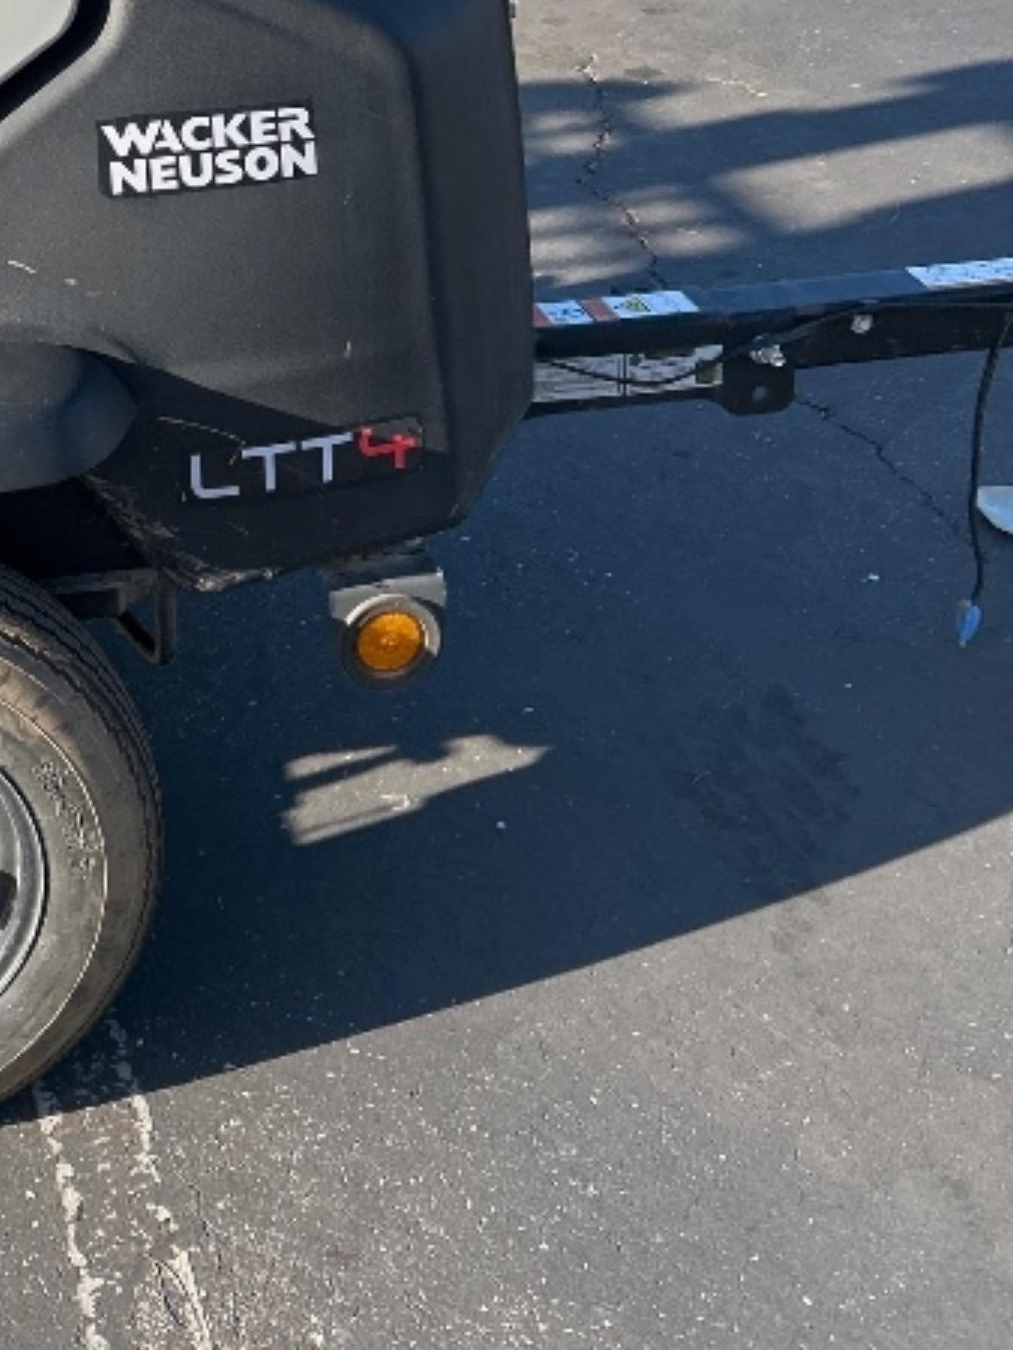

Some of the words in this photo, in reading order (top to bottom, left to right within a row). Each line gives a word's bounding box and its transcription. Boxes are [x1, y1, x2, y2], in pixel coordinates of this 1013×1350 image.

[100, 106, 316, 158] WACKER
[108, 140, 319, 197] NEUSON
[190, 426, 418, 500] LTT4
